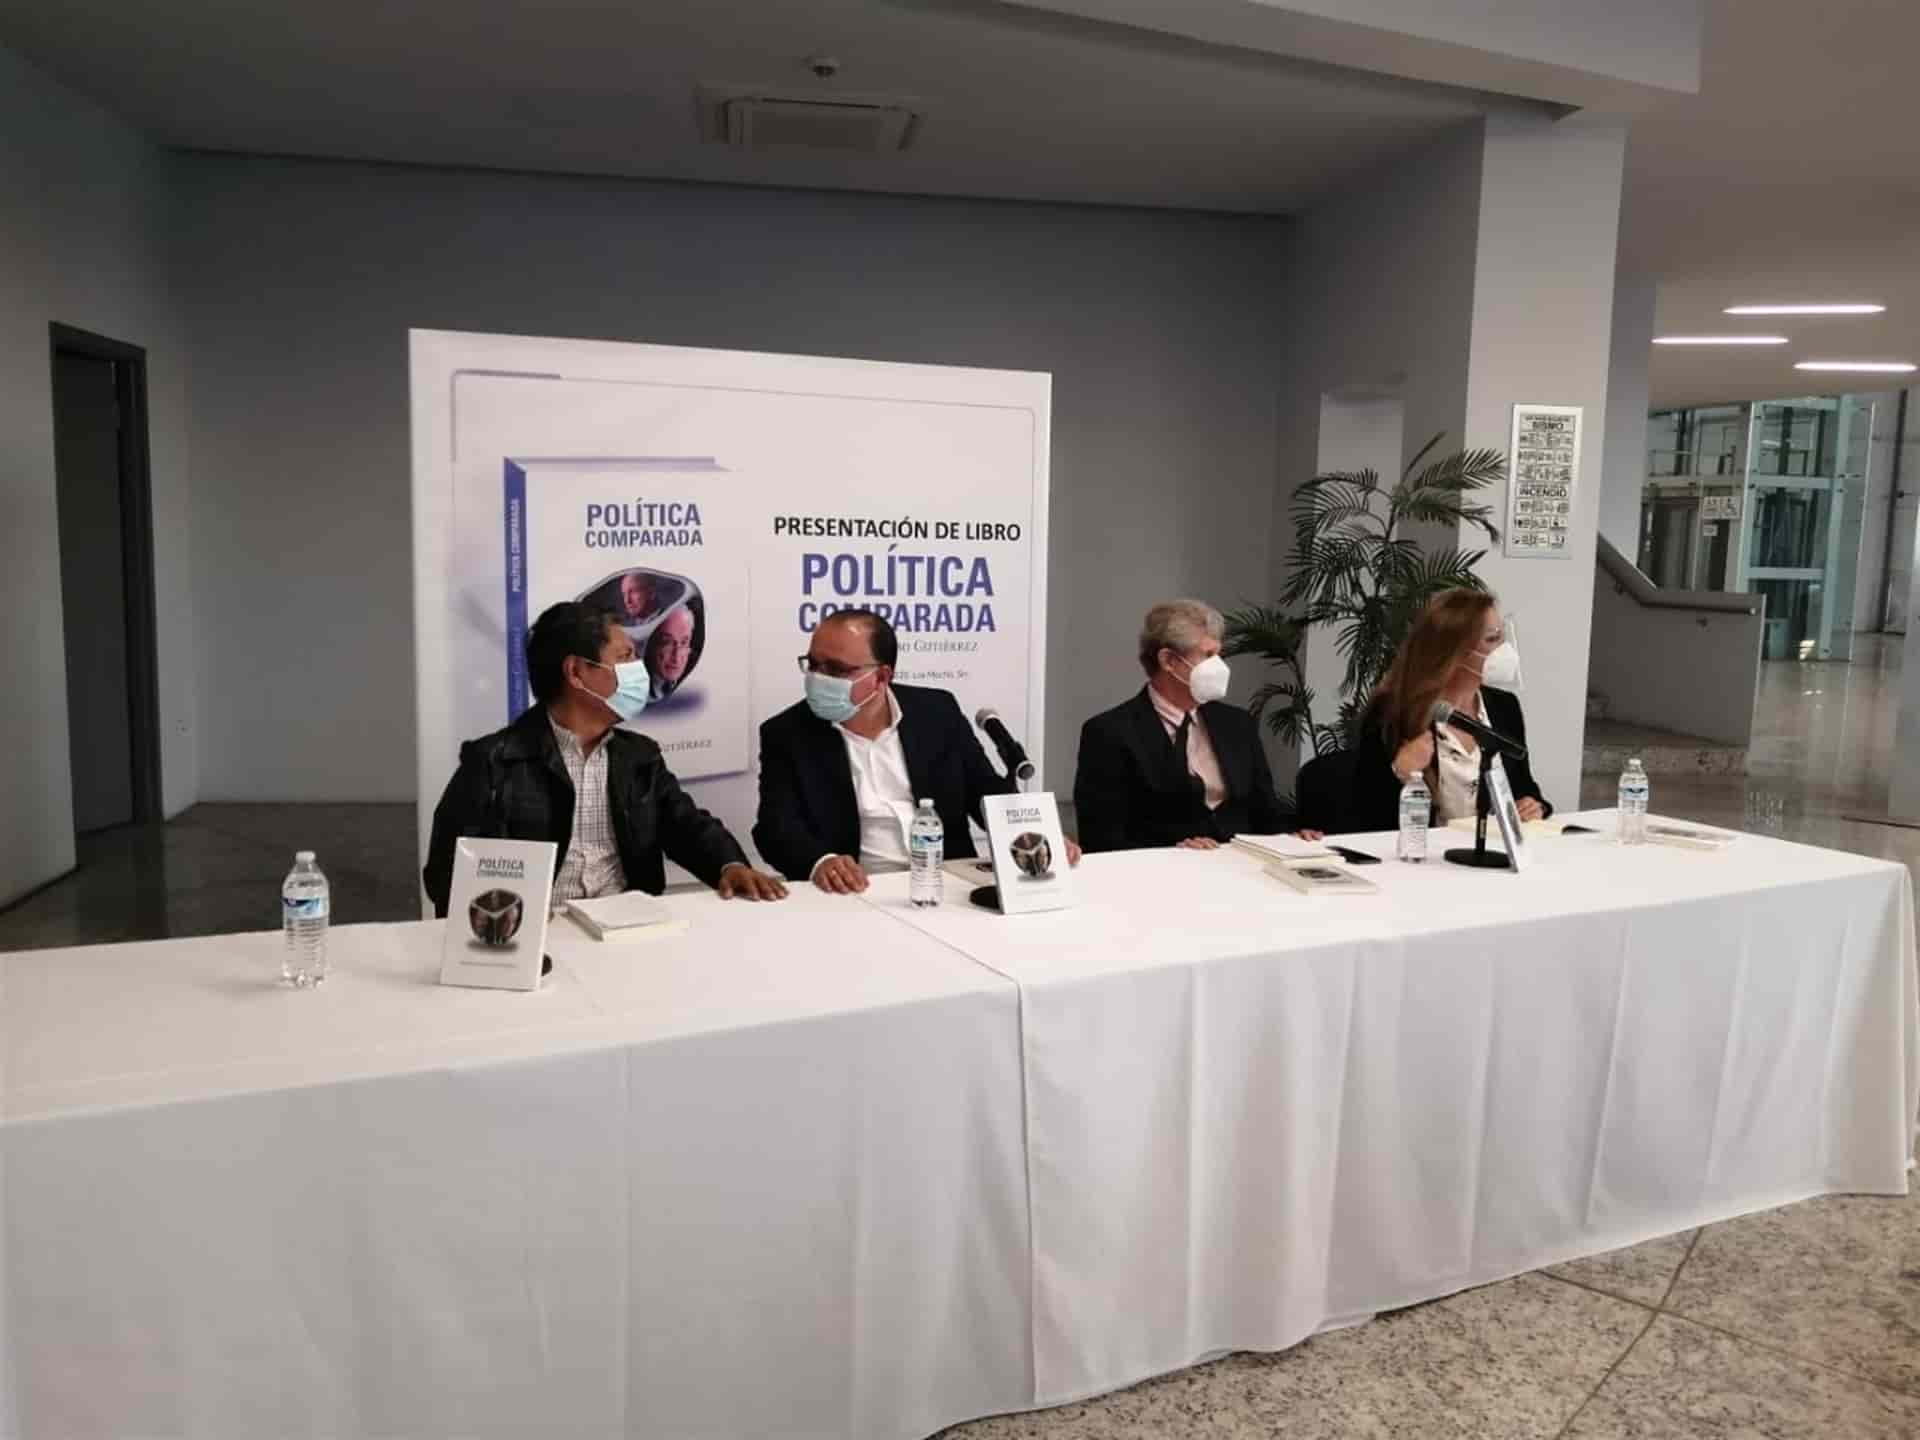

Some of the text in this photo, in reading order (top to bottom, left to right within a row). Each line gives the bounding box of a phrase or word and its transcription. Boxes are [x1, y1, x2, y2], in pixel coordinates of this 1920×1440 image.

[586, 497, 702, 527] POLÍTICA
[584, 529, 704, 548] COMPARADA
[773, 516, 1021, 541] PRESENTACIÓN DE LIBRO
[802, 543, 995, 597] POLÍTICA
[798, 602, 996, 633] CPARADA
